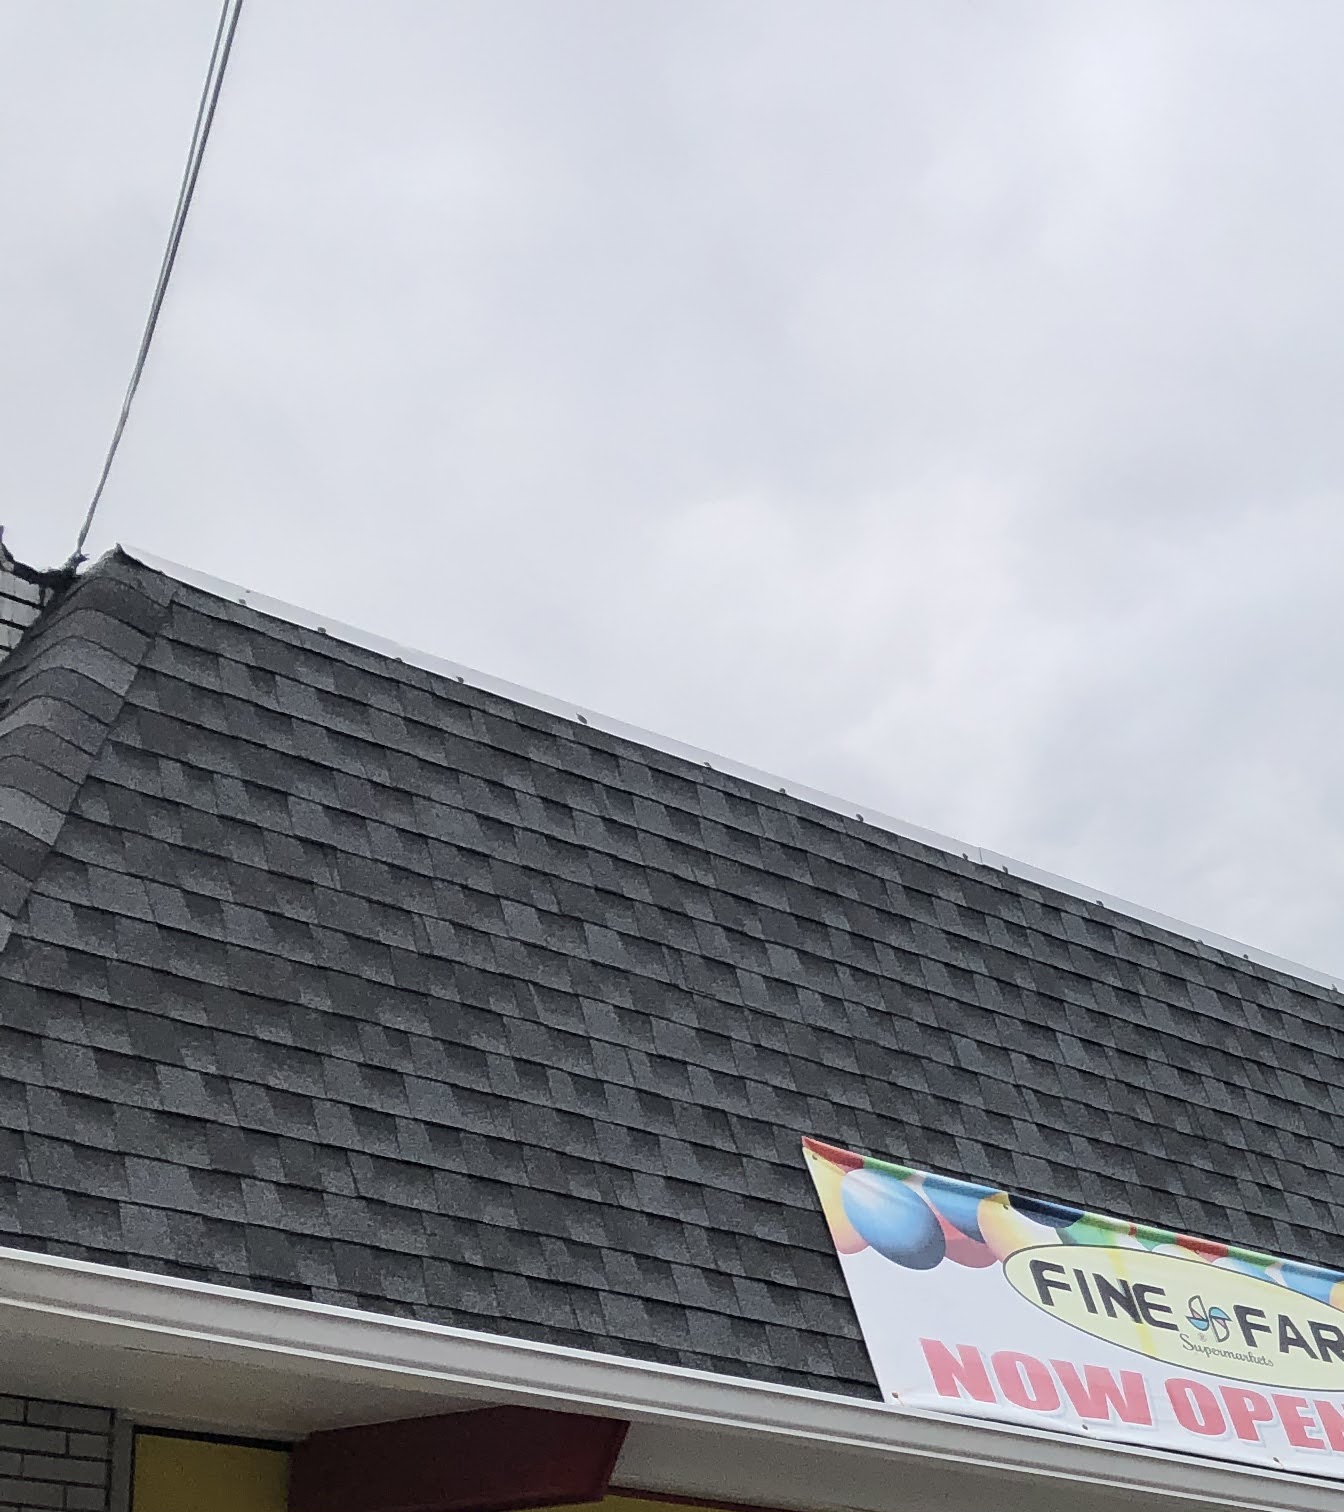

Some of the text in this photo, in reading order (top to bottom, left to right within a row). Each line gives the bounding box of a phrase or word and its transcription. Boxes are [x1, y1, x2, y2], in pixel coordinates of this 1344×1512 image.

[1029, 1258, 1180, 1332] FINE
[919, 1337, 1154, 1428] NOW
[1179, 1333, 1274, 1367] Supermarkets
